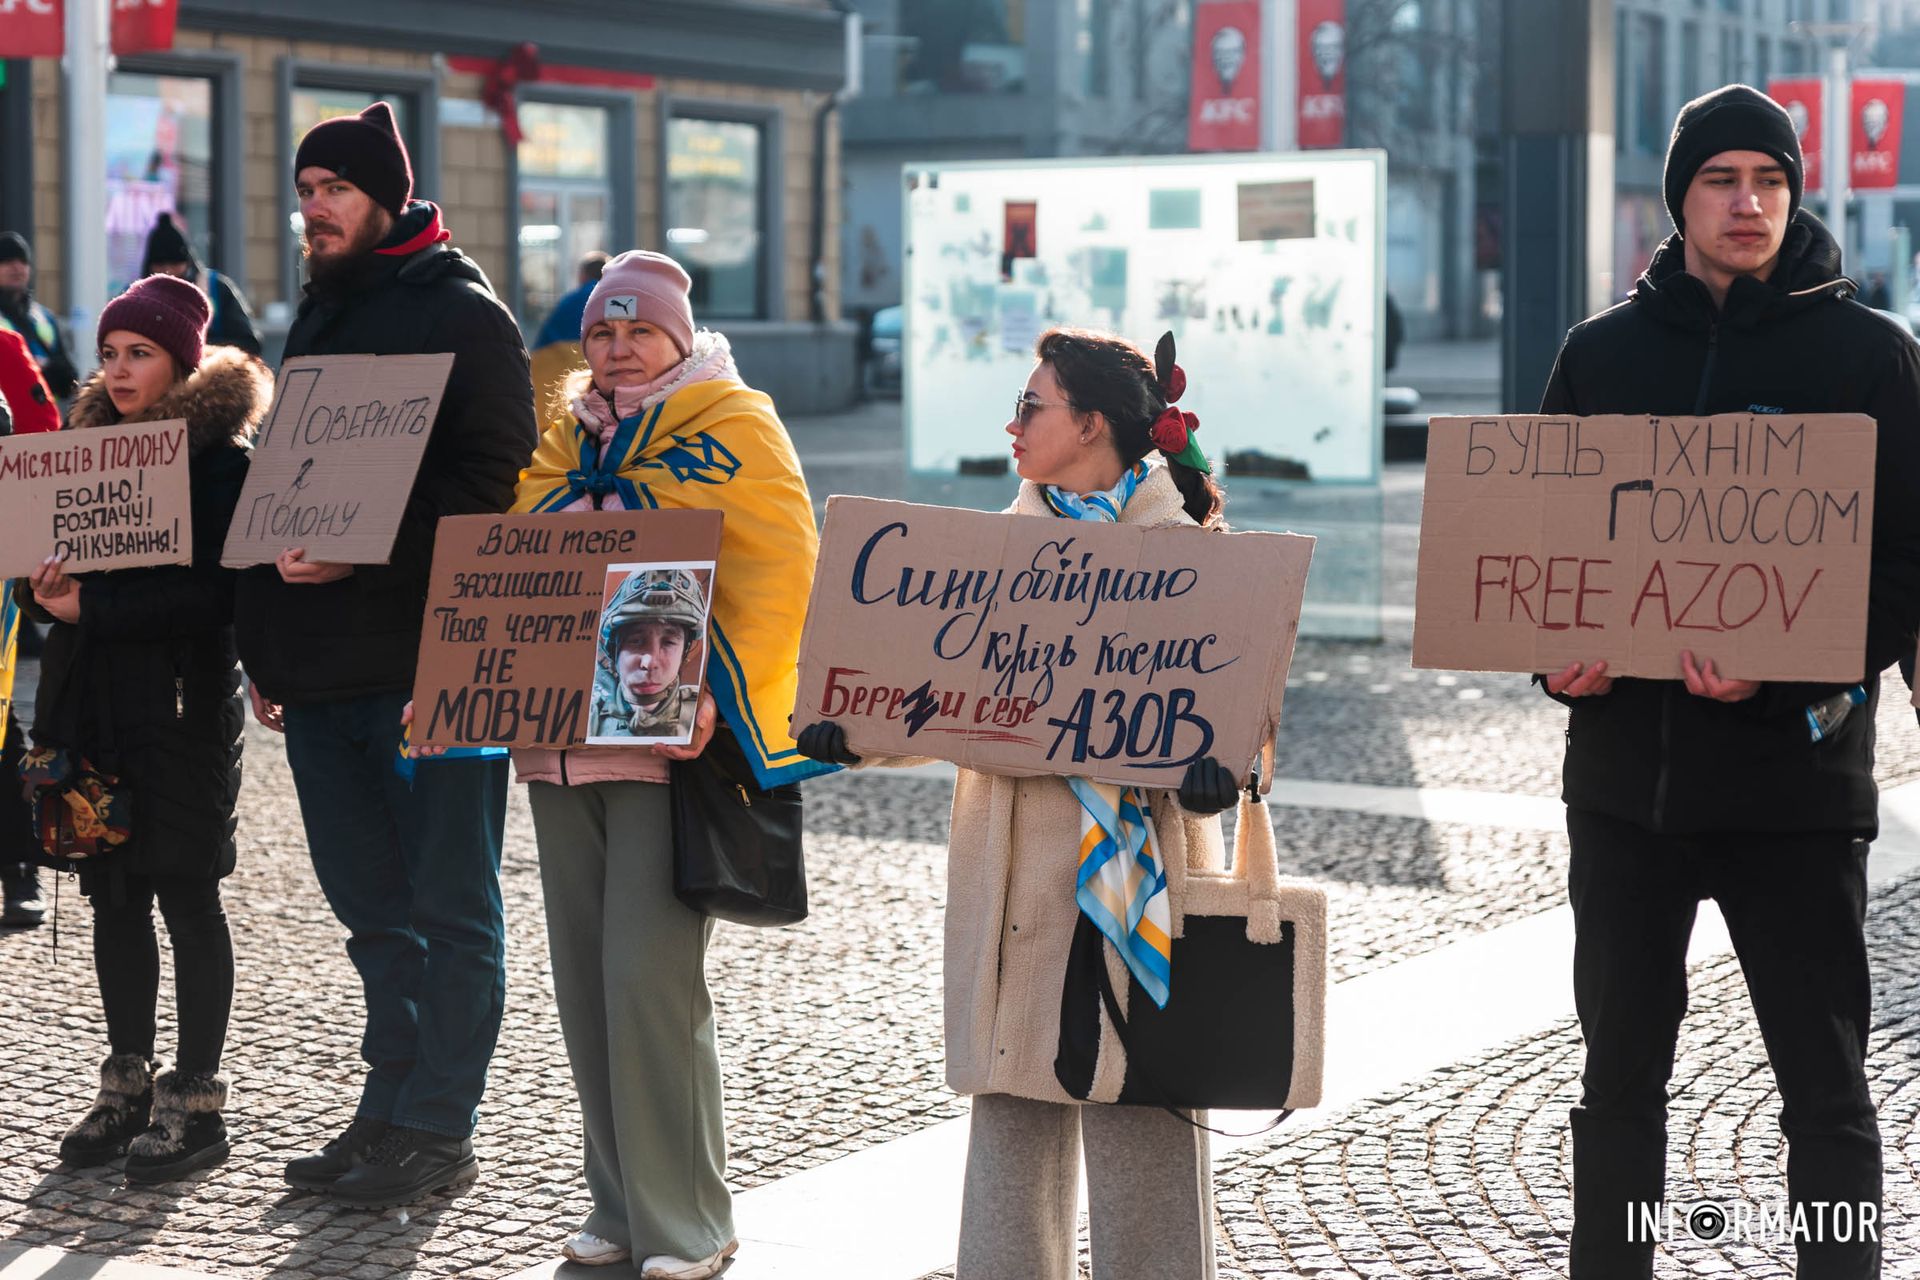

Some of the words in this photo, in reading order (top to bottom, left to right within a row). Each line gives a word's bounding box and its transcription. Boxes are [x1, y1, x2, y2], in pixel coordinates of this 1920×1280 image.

[99, 428, 185, 473] ПОЛОНУ
[1467, 422, 1604, 478] БУДЬ
[1649, 418, 1804, 476] ЇХНІМ
[56, 469, 143, 509] БОЛЮ!
[53, 497, 153, 539] РОЗПАЧУ!
[1609, 479, 1859, 546] ГОЛОСОМ
[477, 523, 552, 556] Вони
[559, 529, 636, 554] тебе
[1009, 537, 1198, 626] обіймаю
[1475, 555, 1612, 630] FREE
[1631, 559, 1823, 633] AZOV
[434, 607, 488, 643] Твоя
[473, 648, 517, 684] НЕ
[973, 696, 1038, 728] себе
[1045, 688, 1214, 769] АЗОВ
